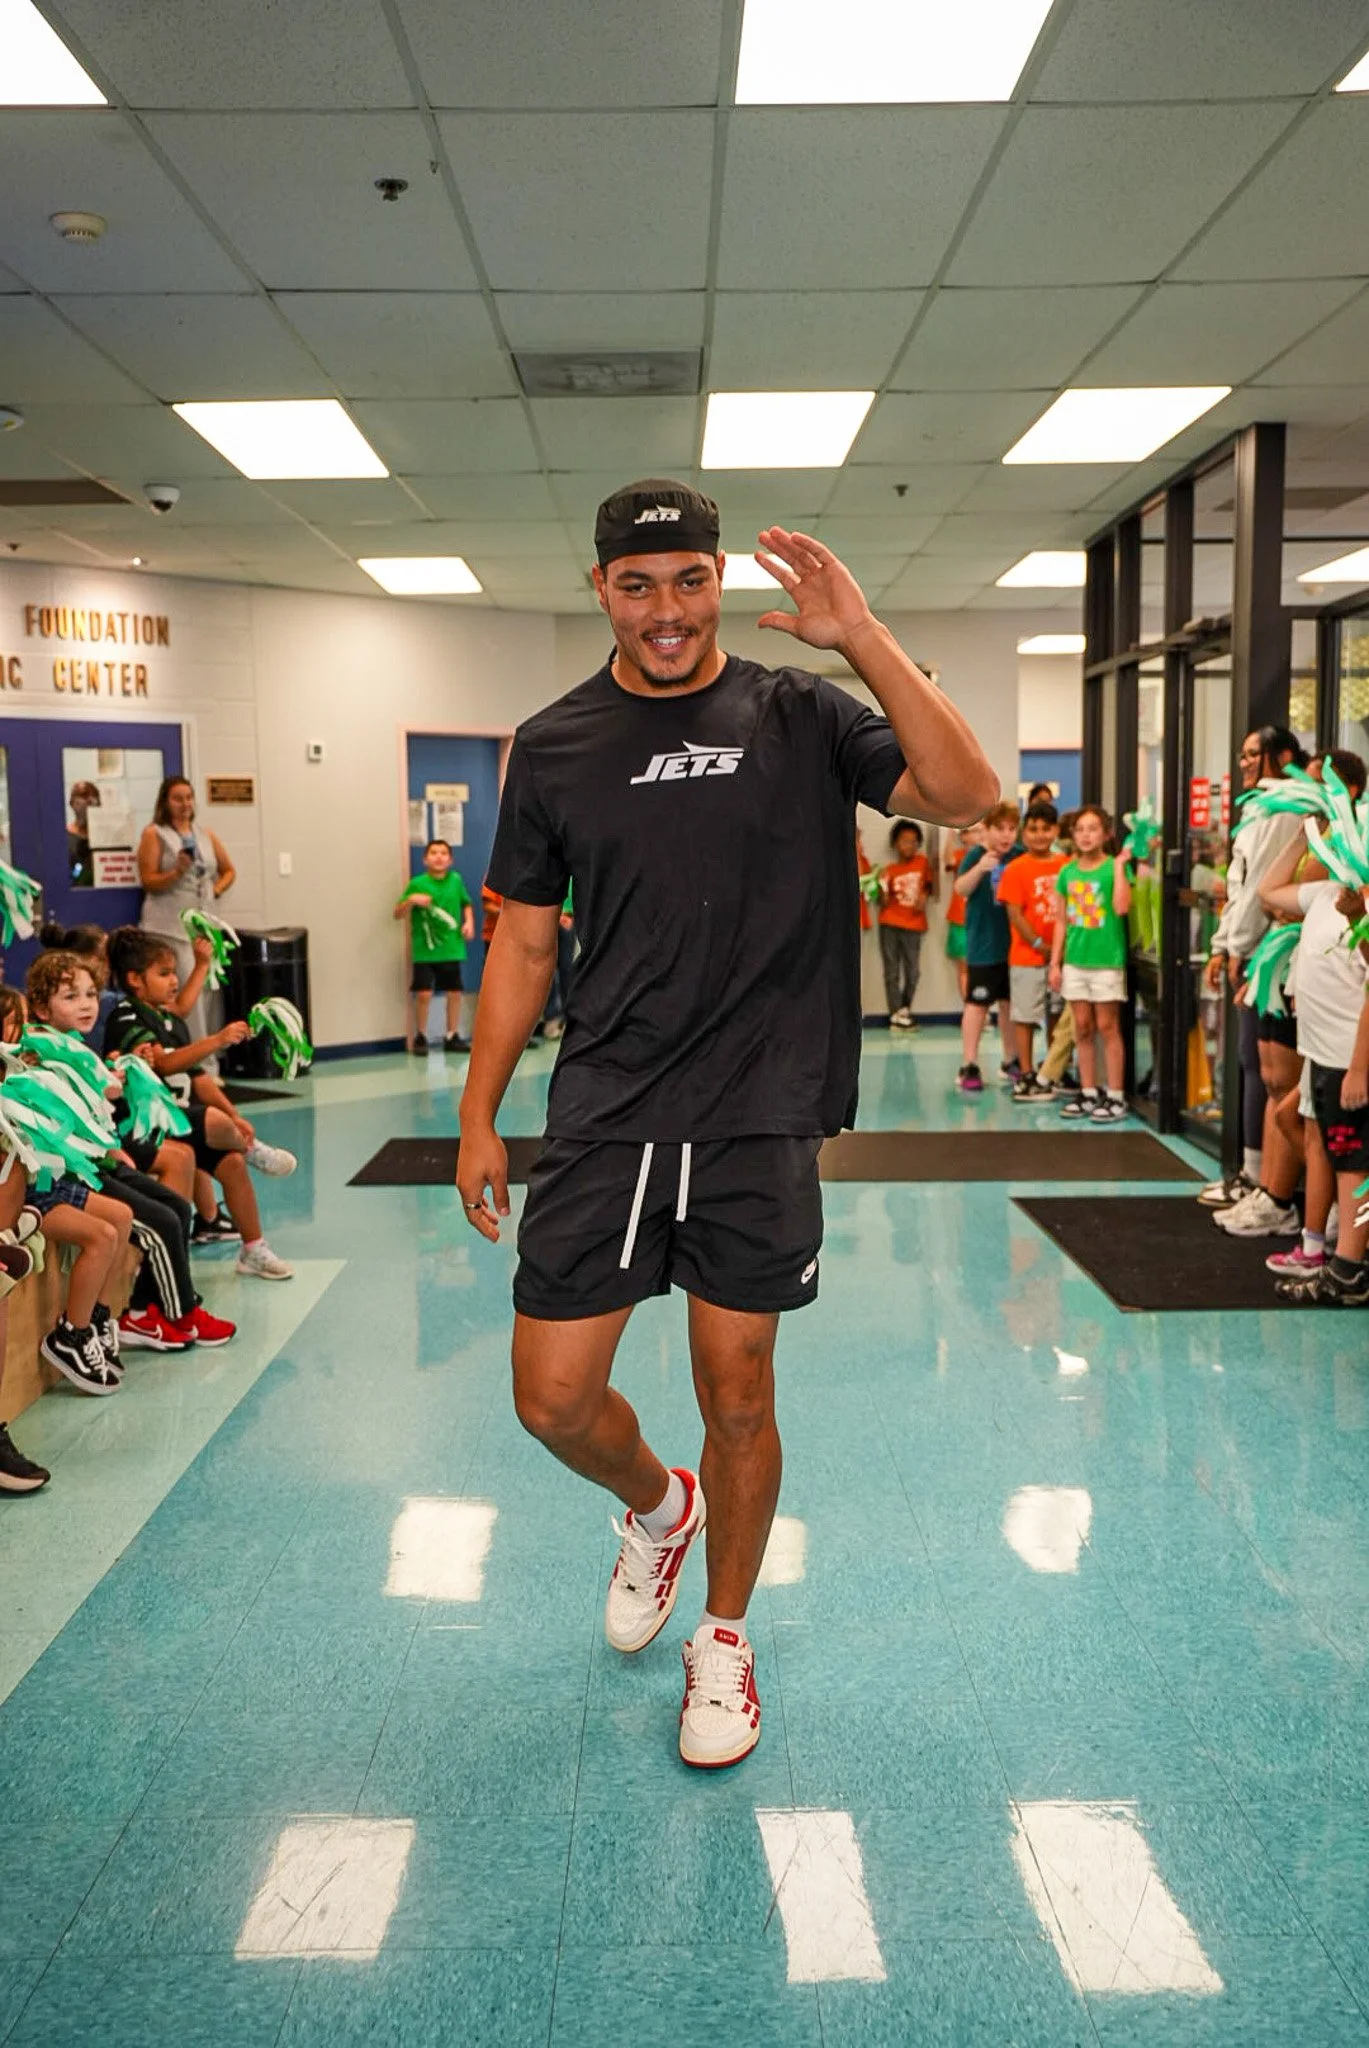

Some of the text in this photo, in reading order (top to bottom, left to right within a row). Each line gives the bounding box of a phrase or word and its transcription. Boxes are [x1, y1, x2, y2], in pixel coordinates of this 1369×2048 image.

[634, 504, 682, 525] JETS
[24, 603, 170, 647] FOUNDATION
[53, 655, 149, 698] CENTER
[630, 740, 744, 785] JETS
